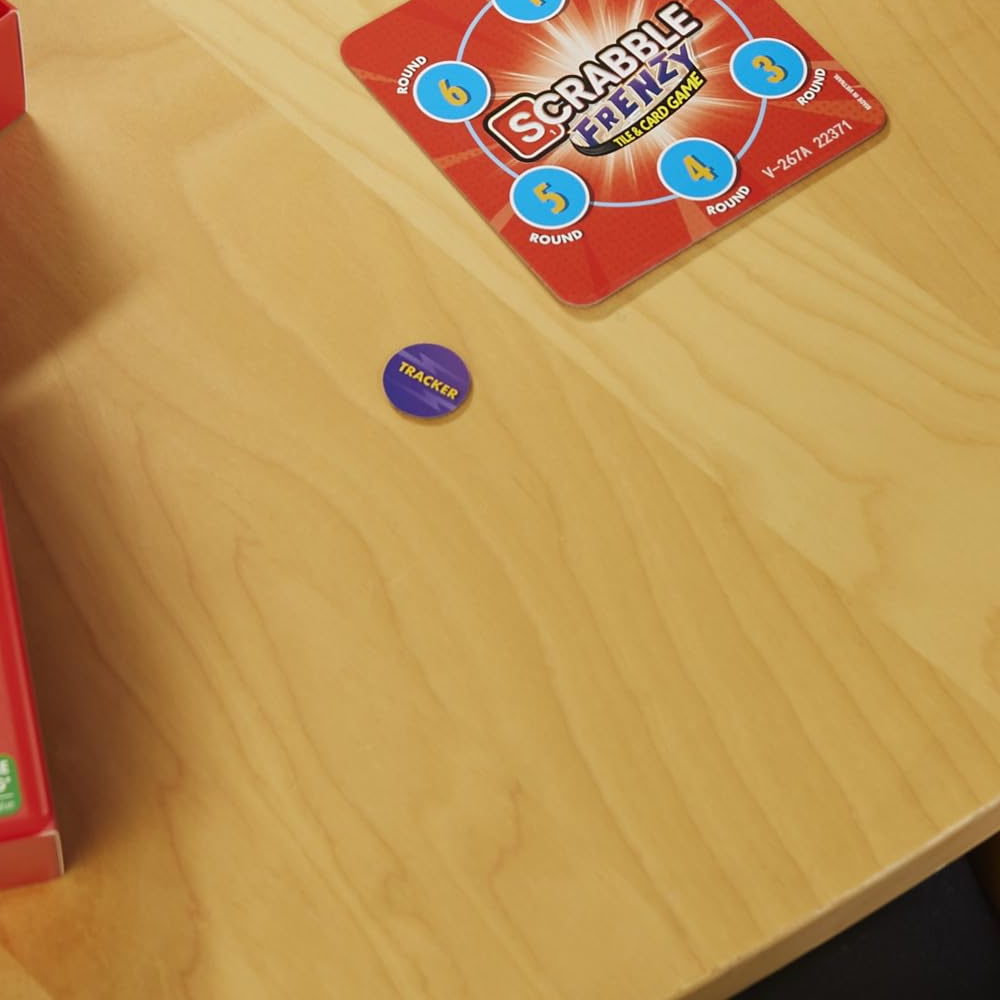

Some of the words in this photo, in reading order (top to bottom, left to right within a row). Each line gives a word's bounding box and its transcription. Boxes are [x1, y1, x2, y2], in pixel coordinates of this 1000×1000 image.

[397, 56, 427, 94] ROUND
[508, 4, 700, 143] SCRABBLE
[753, 55, 786, 84] 3
[796, 68, 826, 106] ROUND
[438, 79, 469, 106] 6
[575, 43, 692, 147] FRENZY
[613, 132, 633, 147] TILE
[632, 127, 642, 138] &
[640, 105, 670, 131] CARD
[667, 71, 703, 110] GAME
[683, 155, 715, 182] 4
[761, 145, 812, 180] V-267A
[813, 120, 853, 148] 22371
[532, 182, 567, 214] 5
[706, 185, 751, 215] ROUND
[529, 229, 584, 245] ROUND
[398, 361, 459, 400] TRACKER
